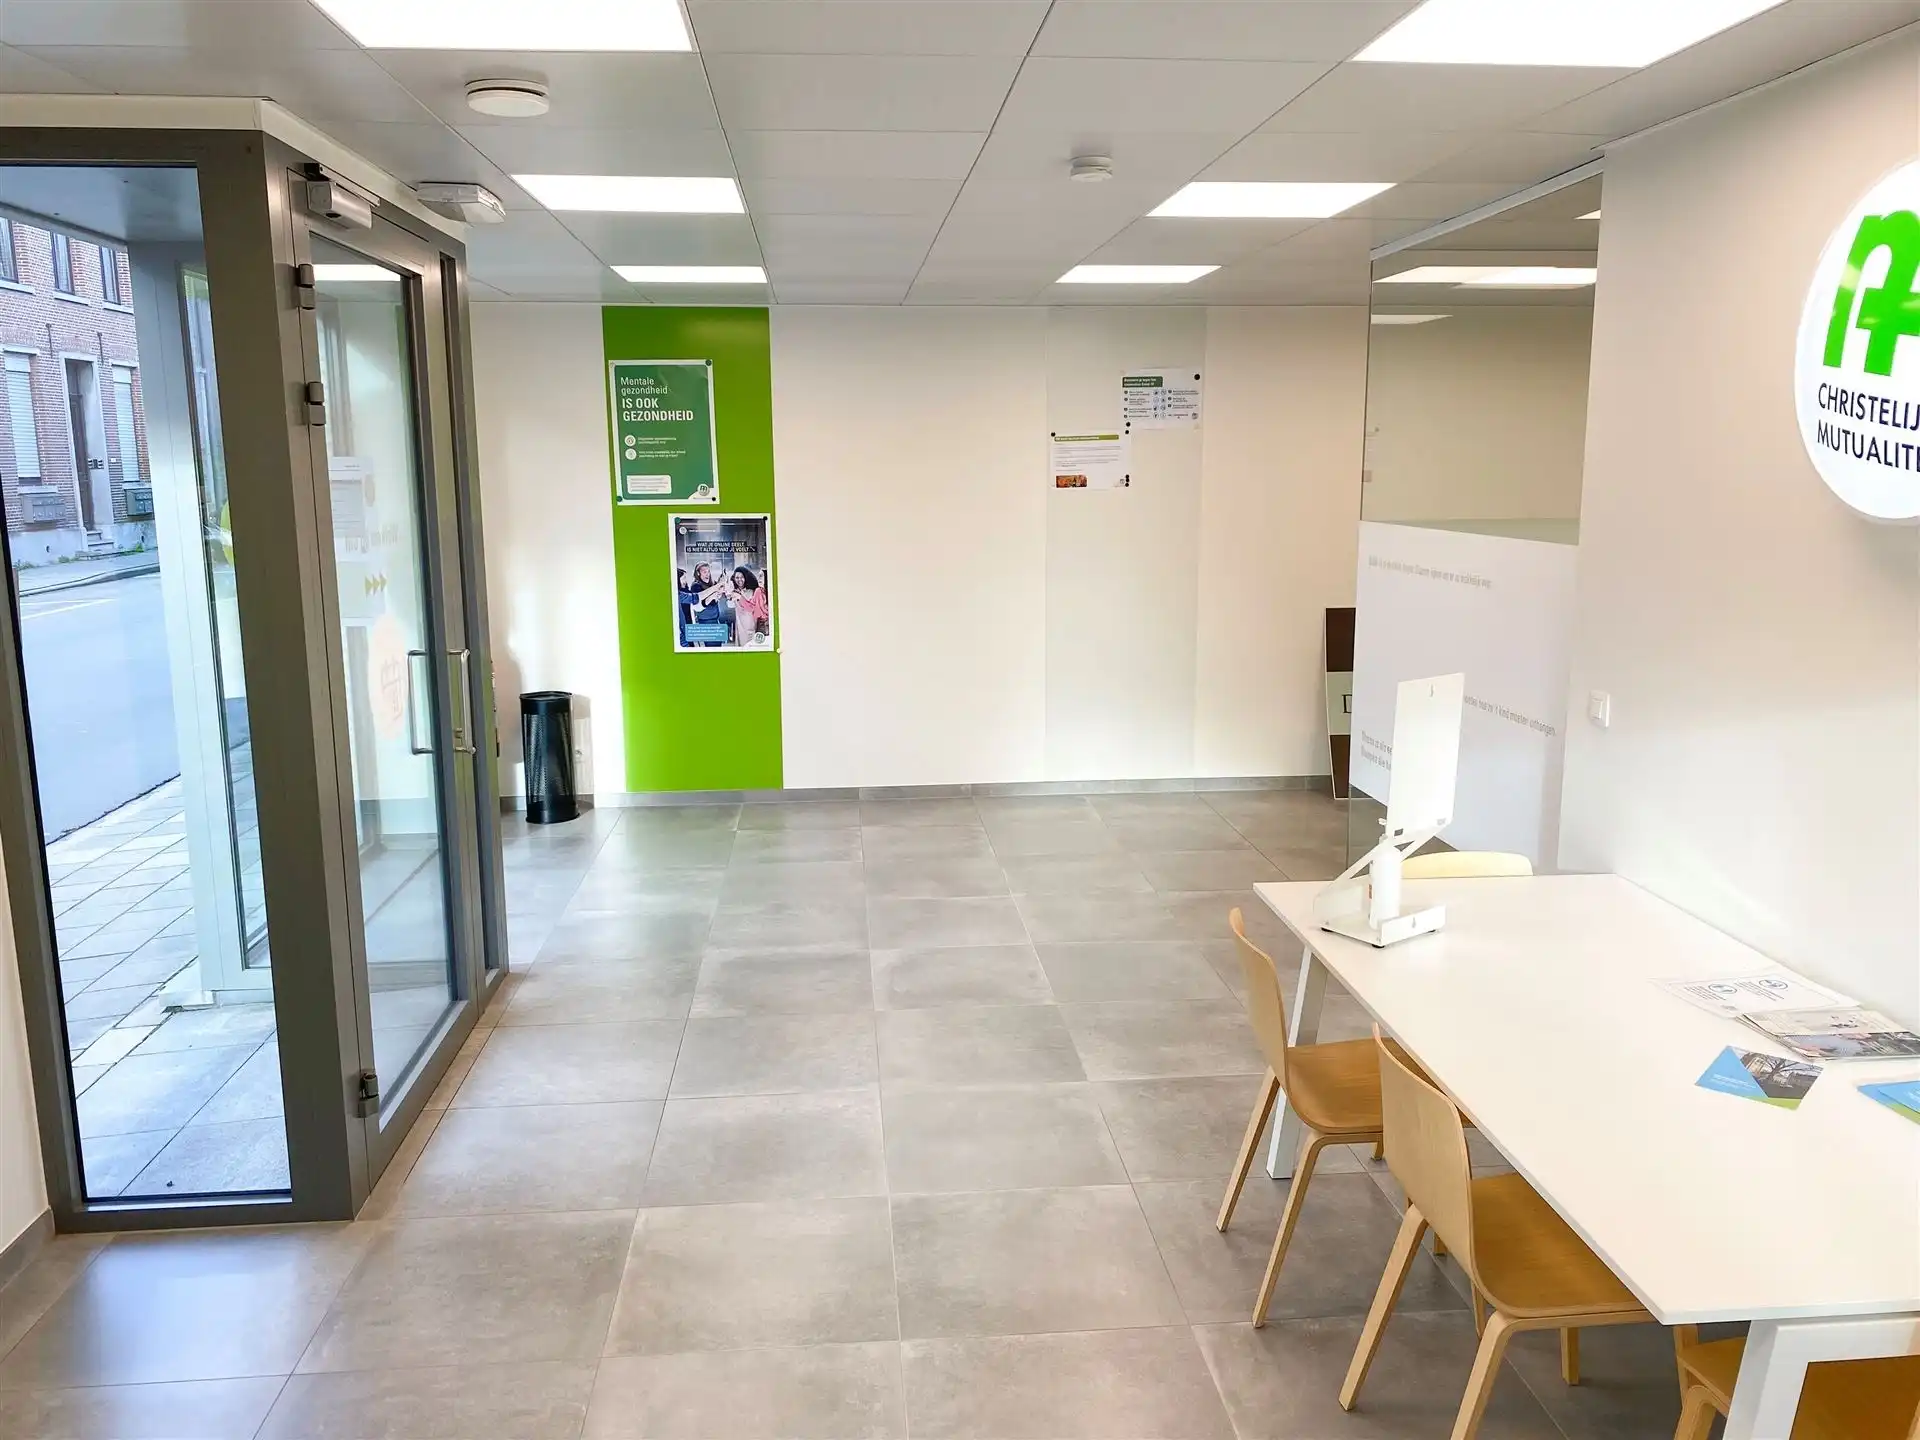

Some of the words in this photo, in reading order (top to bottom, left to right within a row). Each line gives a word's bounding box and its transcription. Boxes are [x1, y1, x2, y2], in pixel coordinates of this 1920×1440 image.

[620, 376, 655, 386] Mentale
[621, 385, 668, 396] gezondheid
[622, 398, 633, 409] IS
[635, 397, 659, 409] OOK
[1818, 382, 1920, 431] CHRISTELIJ
[622, 410, 694, 422] GEZONDHEID
